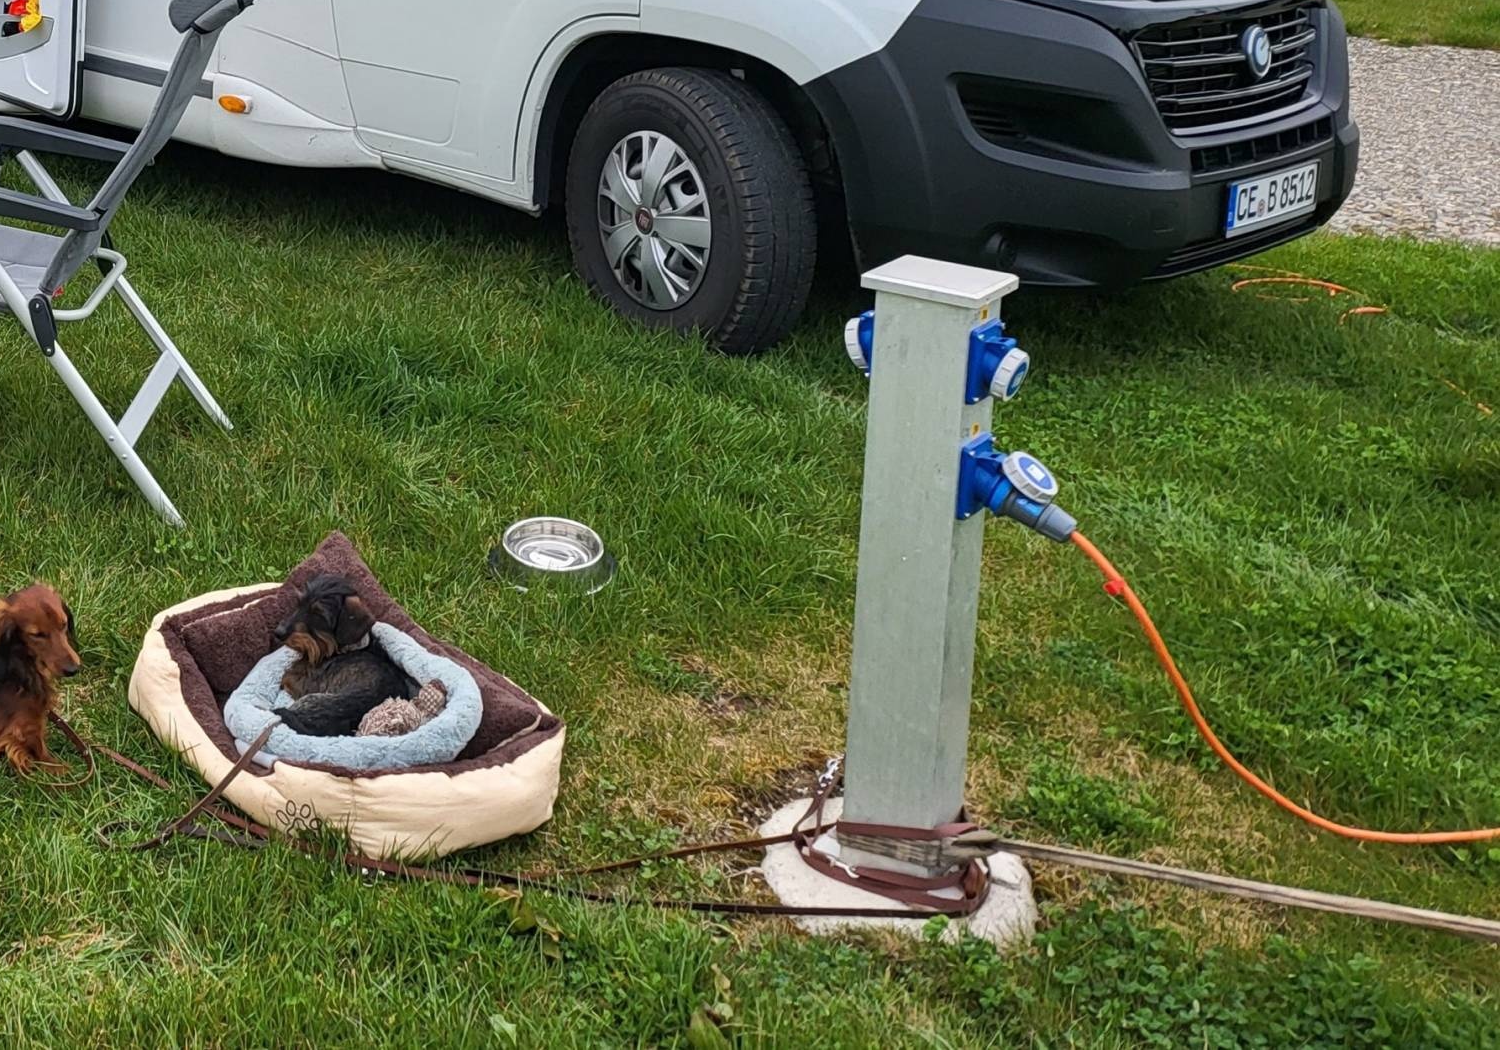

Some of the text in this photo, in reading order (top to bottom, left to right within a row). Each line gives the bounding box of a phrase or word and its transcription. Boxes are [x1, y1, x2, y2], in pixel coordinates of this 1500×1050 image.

[1237, 168, 1315, 221] CE B 8512
